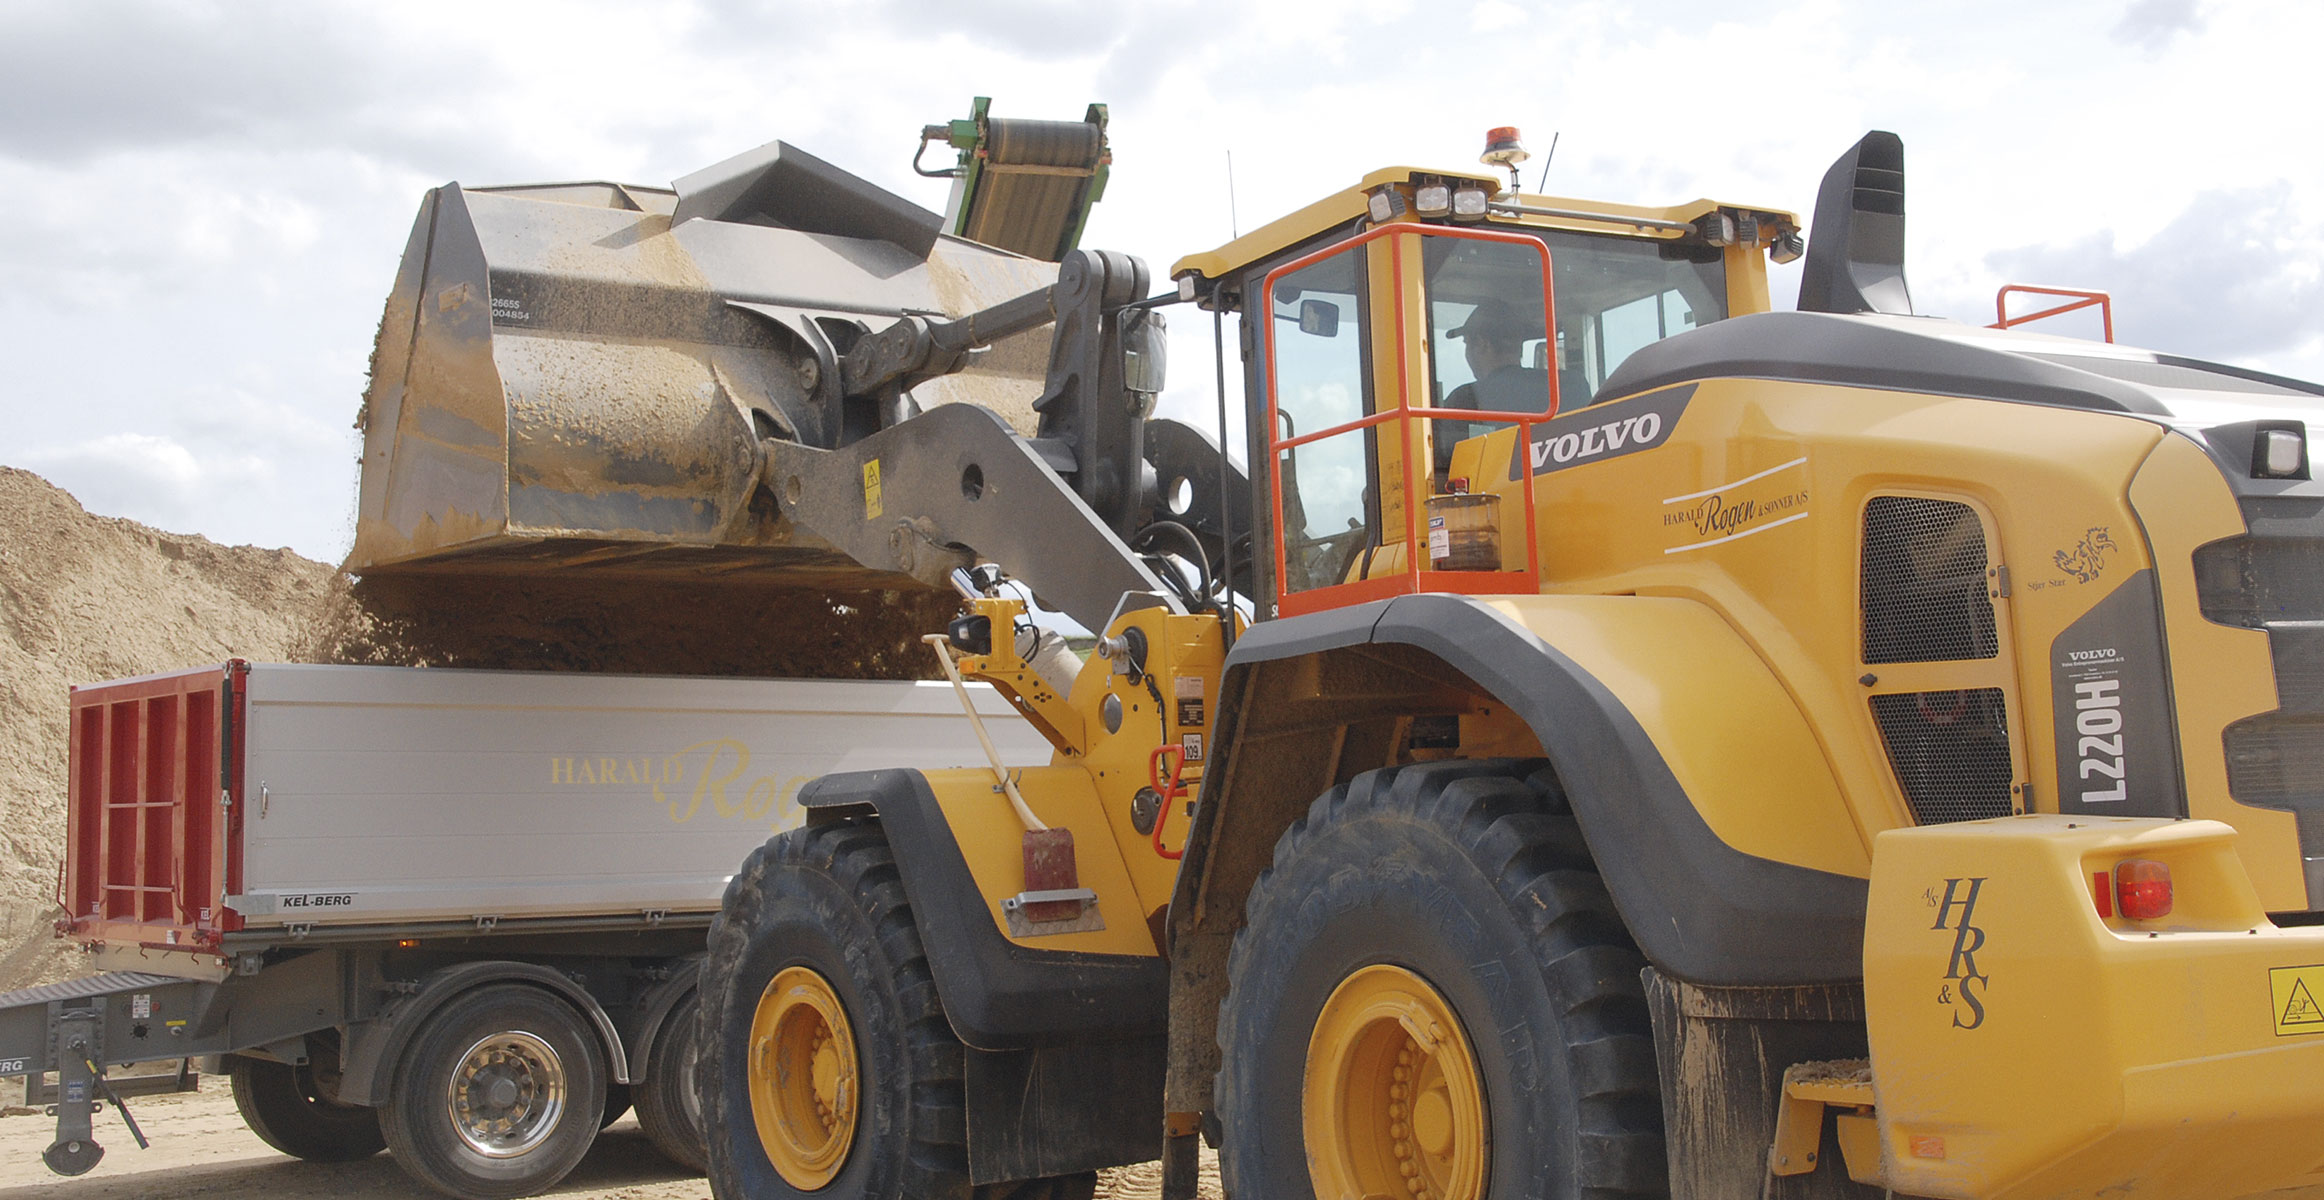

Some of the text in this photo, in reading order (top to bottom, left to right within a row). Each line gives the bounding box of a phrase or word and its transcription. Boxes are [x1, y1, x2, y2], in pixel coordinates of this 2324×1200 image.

[1530, 412, 1662, 469] VOLVO
[1663, 507, 1704, 526] HARALD
[2068, 648, 2117, 661] VOLVO
[2074, 679, 2127, 803] L220H
[1185, 745, 1199, 759] 109
[551, 757, 683, 785] HARALD
[283, 894, 352, 908] KEL-BERG
[1921, 886, 1938, 908] A/S
[0, 1060, 23, 1072] RG
